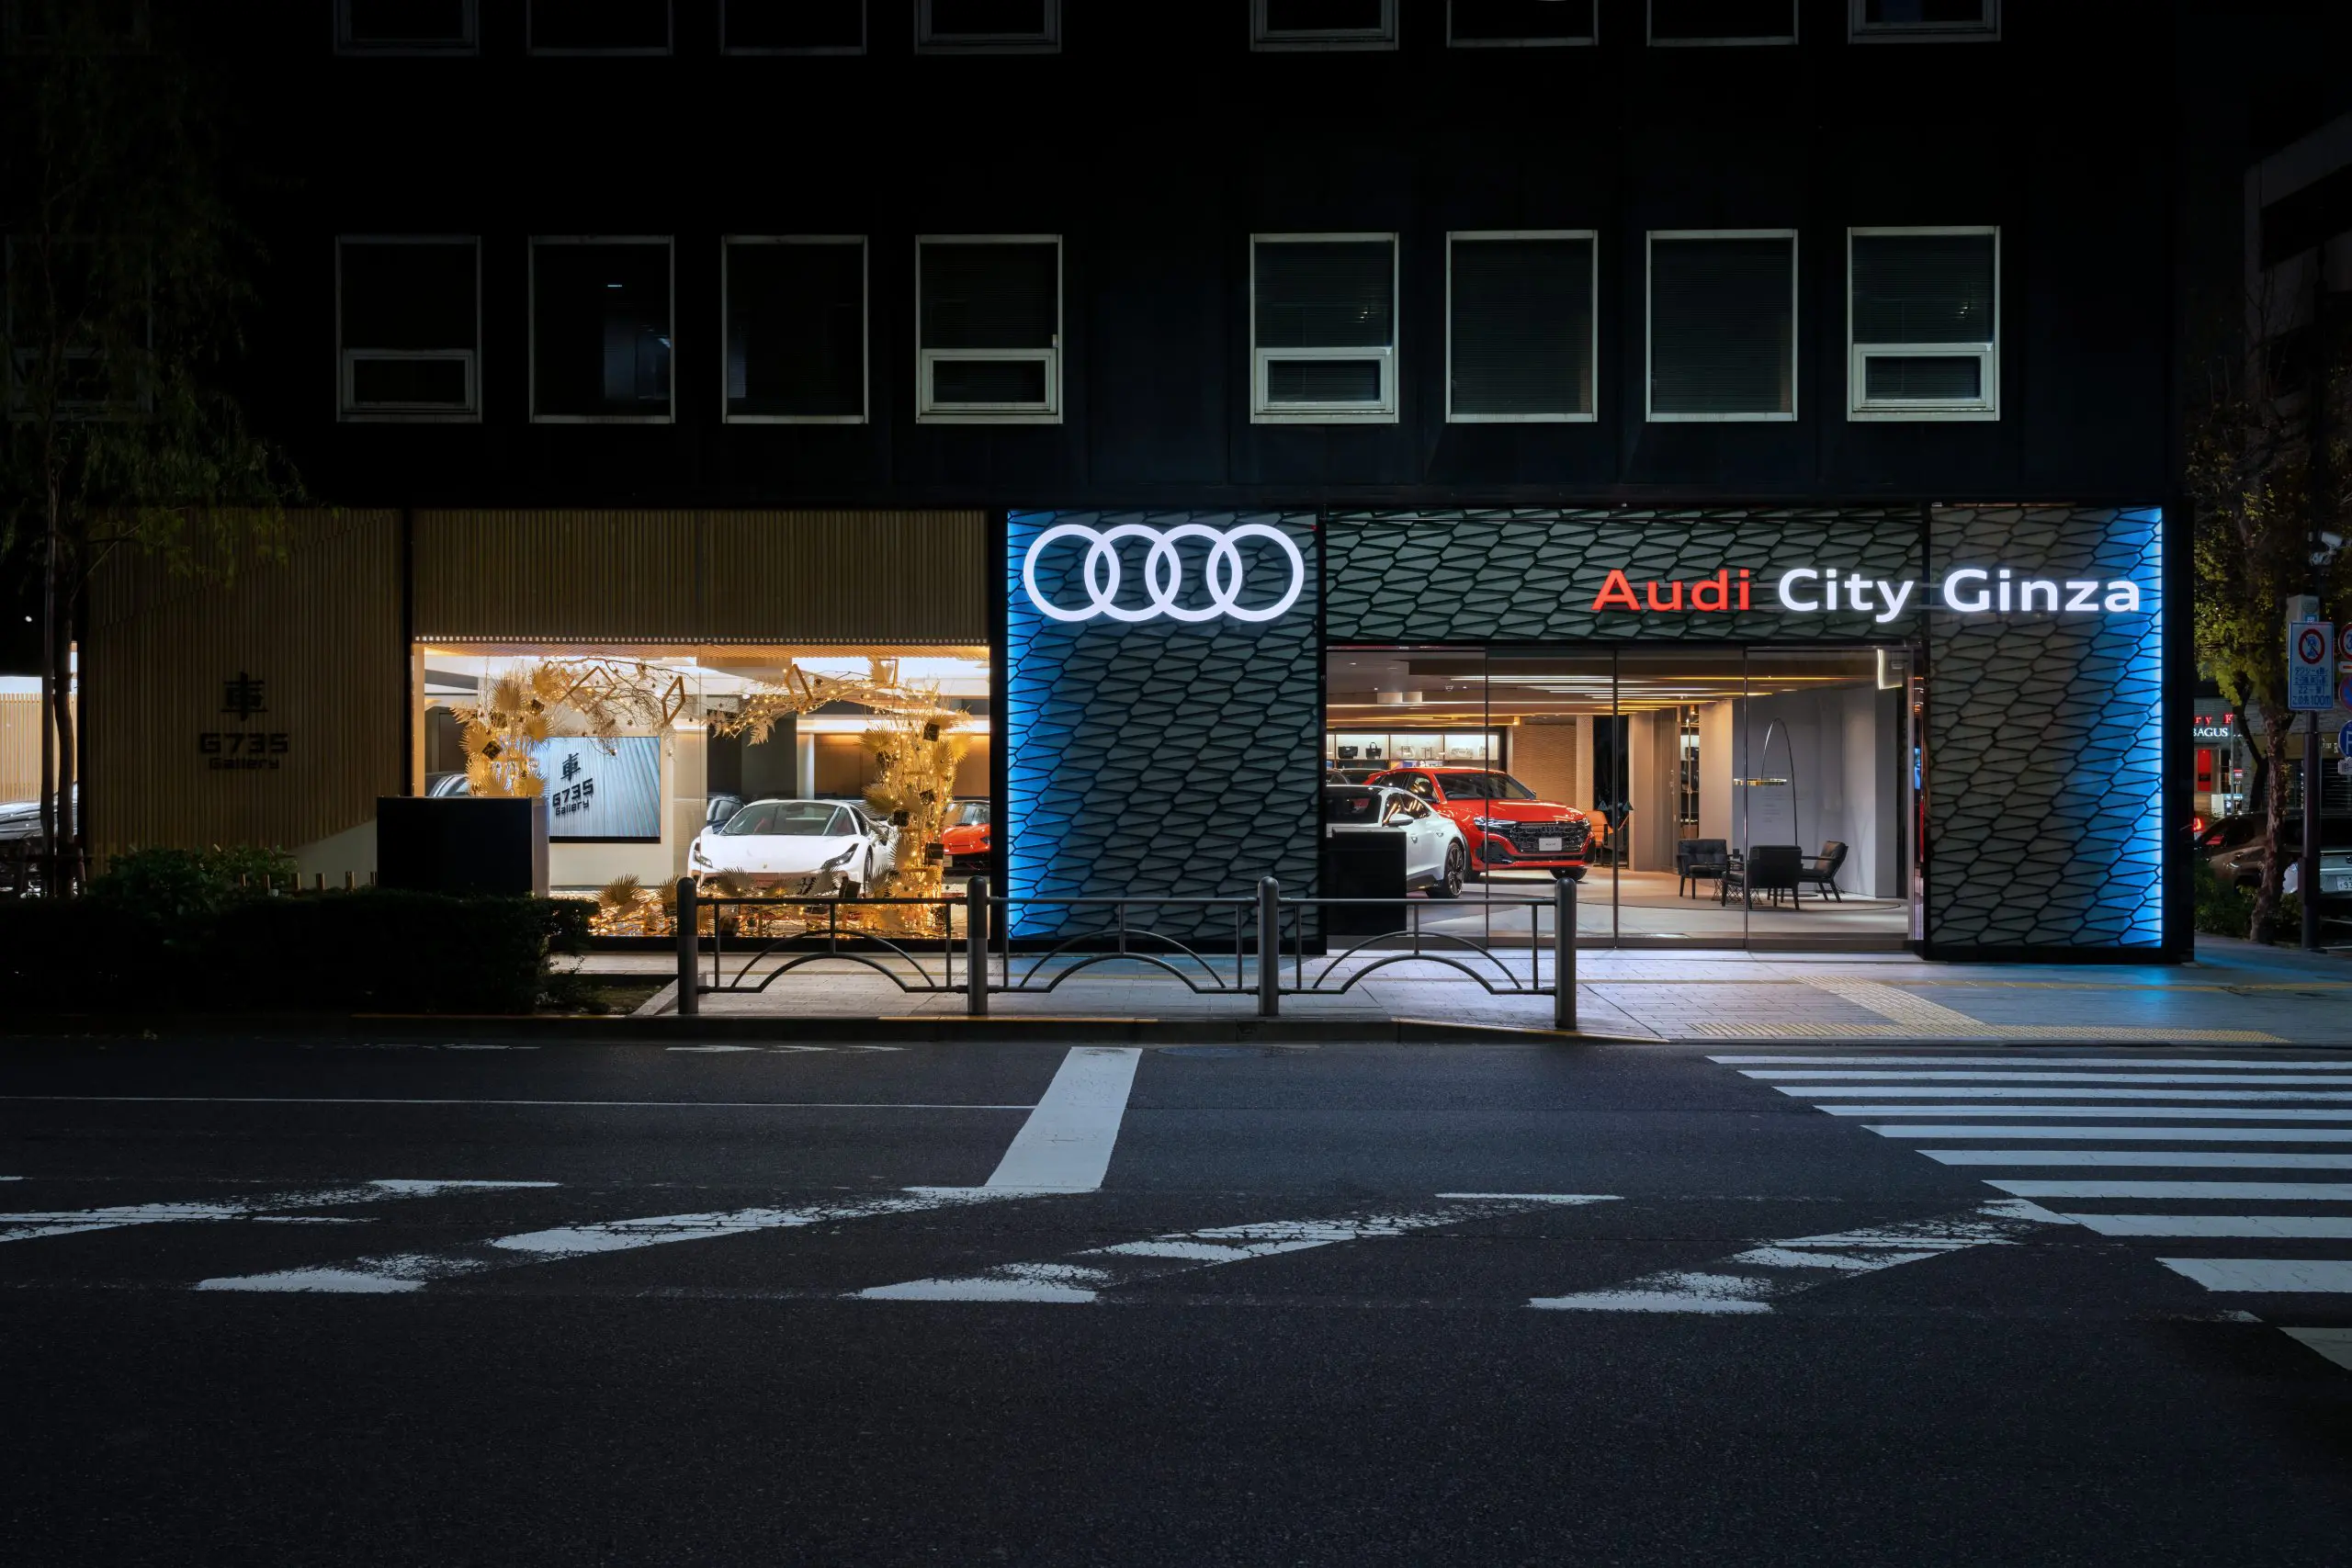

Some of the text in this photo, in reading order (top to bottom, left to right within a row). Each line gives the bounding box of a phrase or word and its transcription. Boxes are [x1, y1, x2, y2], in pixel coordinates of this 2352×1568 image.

[1591, 568, 2140, 623] Audi City Ginza
[220, 671, 268, 721] 車
[209, 758, 279, 769] Gallery
[560, 752, 581, 781] 車
[555, 799, 590, 817] Gallery
